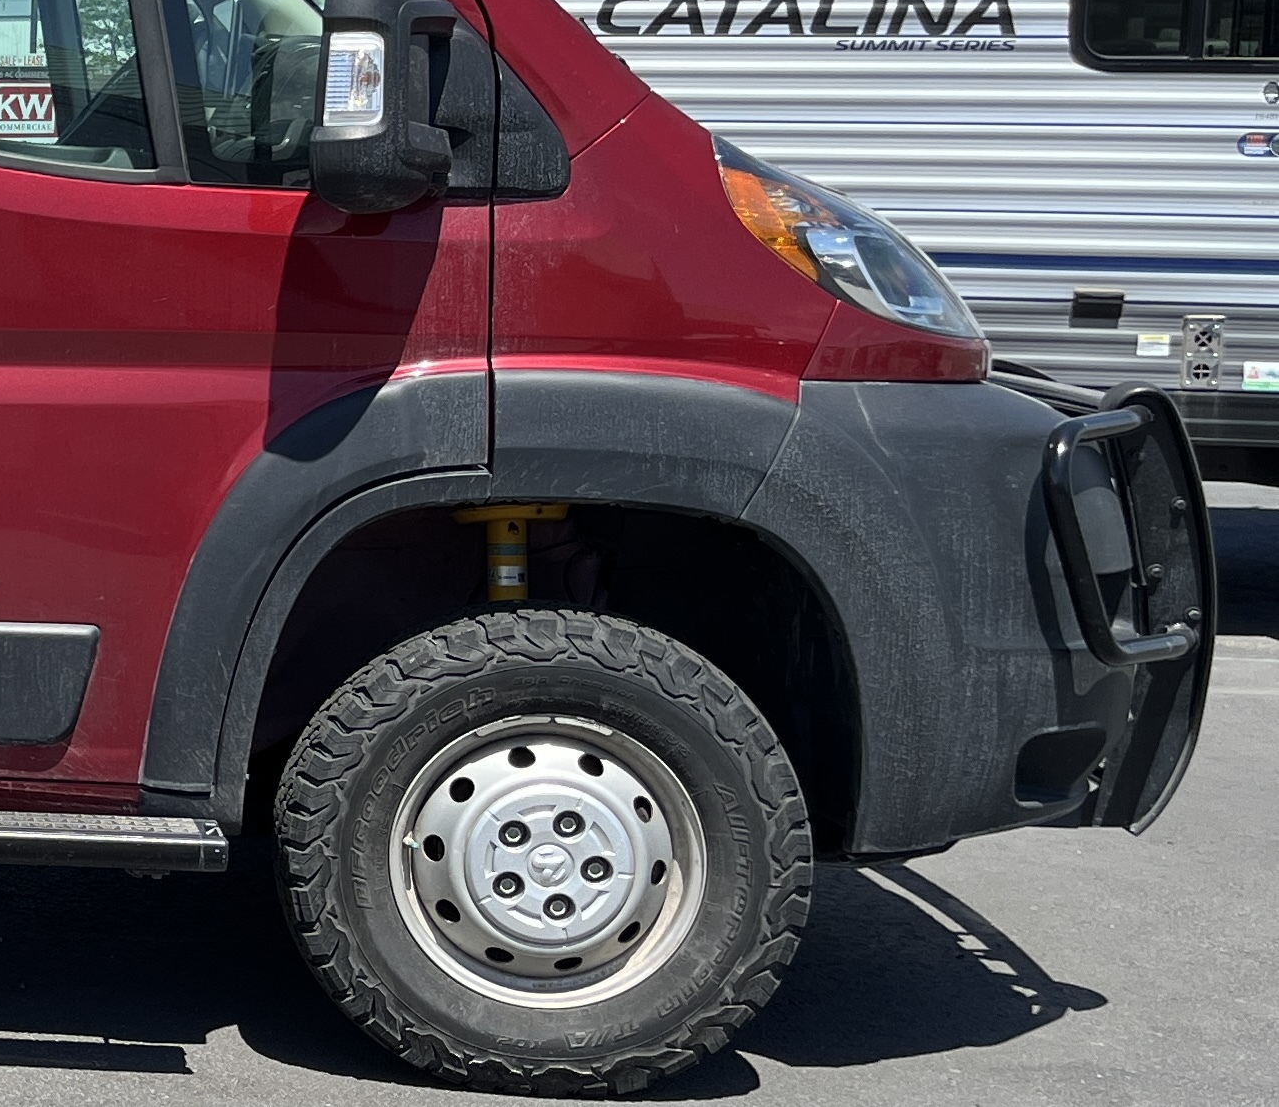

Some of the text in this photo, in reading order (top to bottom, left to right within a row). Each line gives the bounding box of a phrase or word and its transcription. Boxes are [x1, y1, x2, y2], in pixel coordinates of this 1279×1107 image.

[834, 39, 1017, 52] SUMMIT SERIES
[23, 55, 45, 66] LEASE
